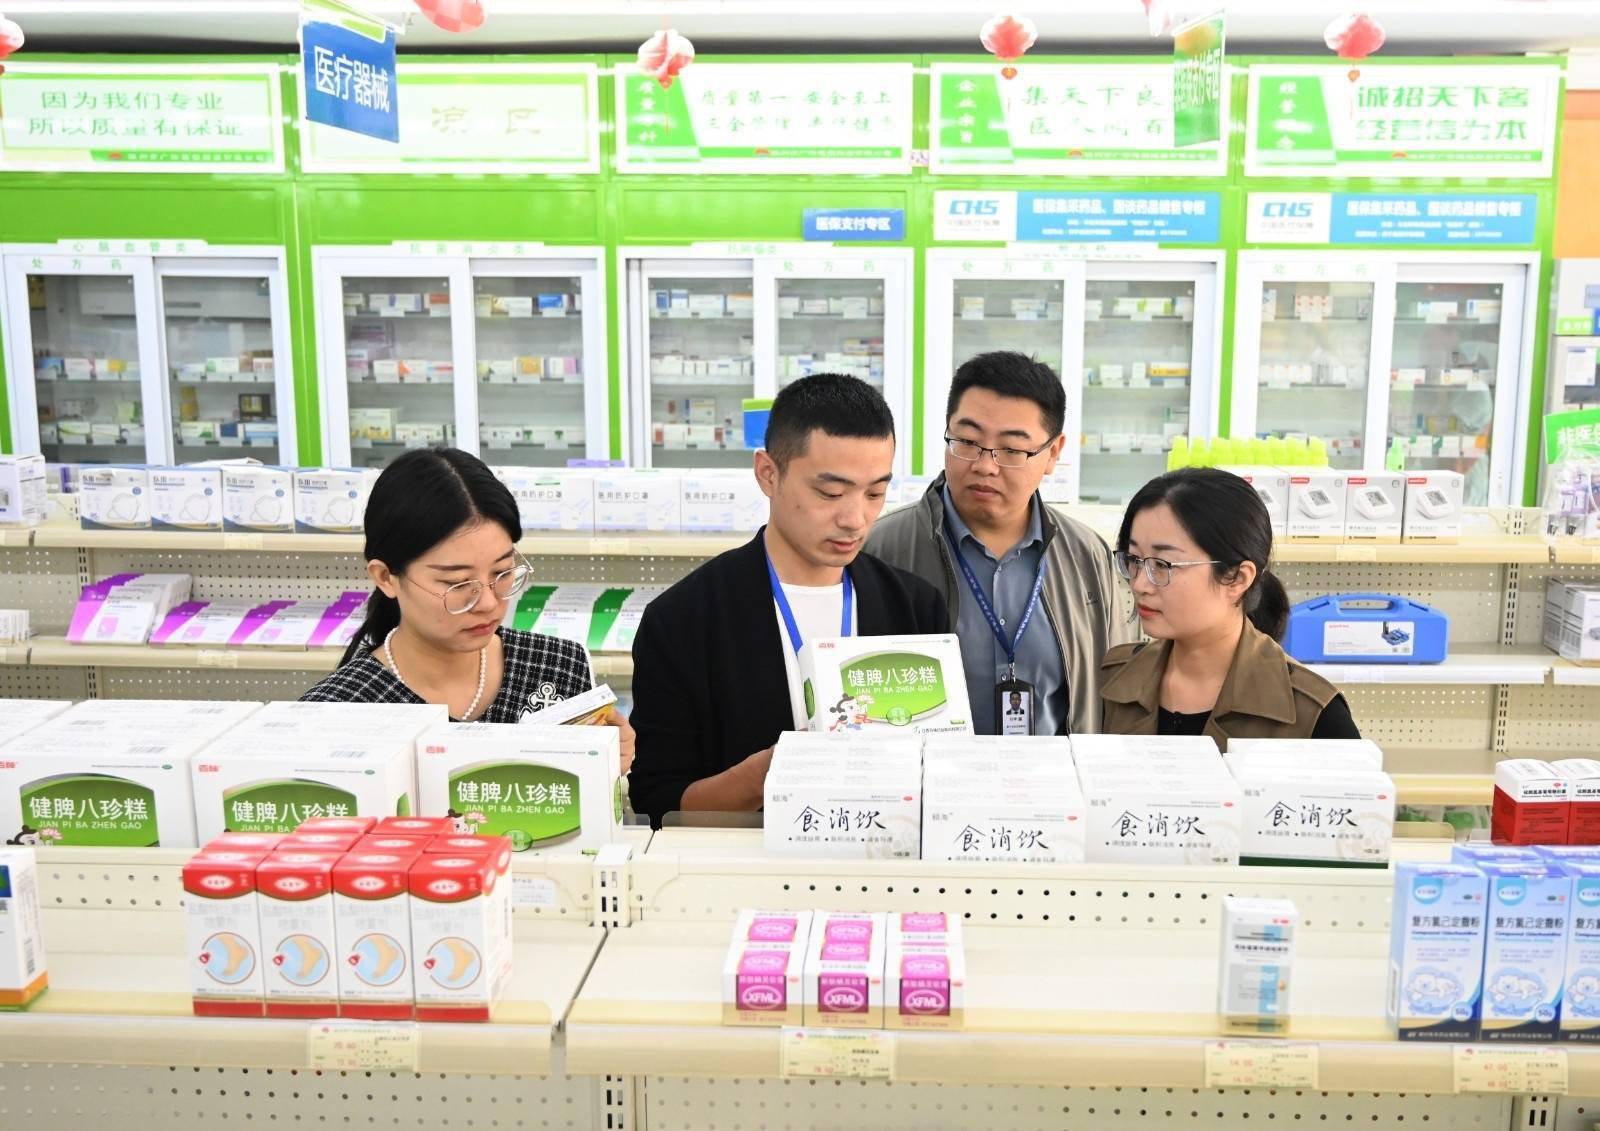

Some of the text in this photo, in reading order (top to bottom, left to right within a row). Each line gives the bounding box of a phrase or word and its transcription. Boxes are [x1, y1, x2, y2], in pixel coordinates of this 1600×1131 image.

[315, 45, 389, 113] 医疗器械
[41, 91, 224, 111] 因为我们专业
[1357, 86, 1530, 108] 诚招天下客
[28, 118, 242, 136] 所以质量有保证
[1355, 119, 1528, 141] 经营信为本
[949, 199, 1000, 216] CHS
[1262, 202, 1313, 218] CHS
[815, 217, 891, 231] 医保支付专区
[73, 241, 187, 254] 心脑血管类
[31, 256, 123, 271] 处方药
[782, 260, 876, 273] 处方药
[962, 259, 1056, 274] 处方药
[847, 665, 938, 688] 健脾八珍糕
[855, 687, 871, 696] JIAN
[917, 684, 934, 693] GAO
[456, 781, 572, 805] 健脾八珍糕
[29, 796, 148, 820] 健脾八珍糕
[232, 800, 349, 823] 健脾八珍糕
[464, 804, 565, 815] JIAN PI BA ZHEN GAO
[1264, 800, 1359, 828] 食消饮
[38, 820, 142, 830] JIAN PI BA ZHEN GAO
[793, 805, 887, 833] 食消饮
[1111, 810, 1206, 838] 食消饮
[240, 824, 290, 833] JIAN PI BA
[953, 824, 1050, 852] 食消饮
[1412, 915, 1480, 928] 复方氯己定撒粉
[1496, 916, 1564, 928] 复方氯己定撒粉
[748, 992, 774, 1002] XFML
[830, 994, 856, 1004] XFML
[912, 997, 938, 1007] XFML
